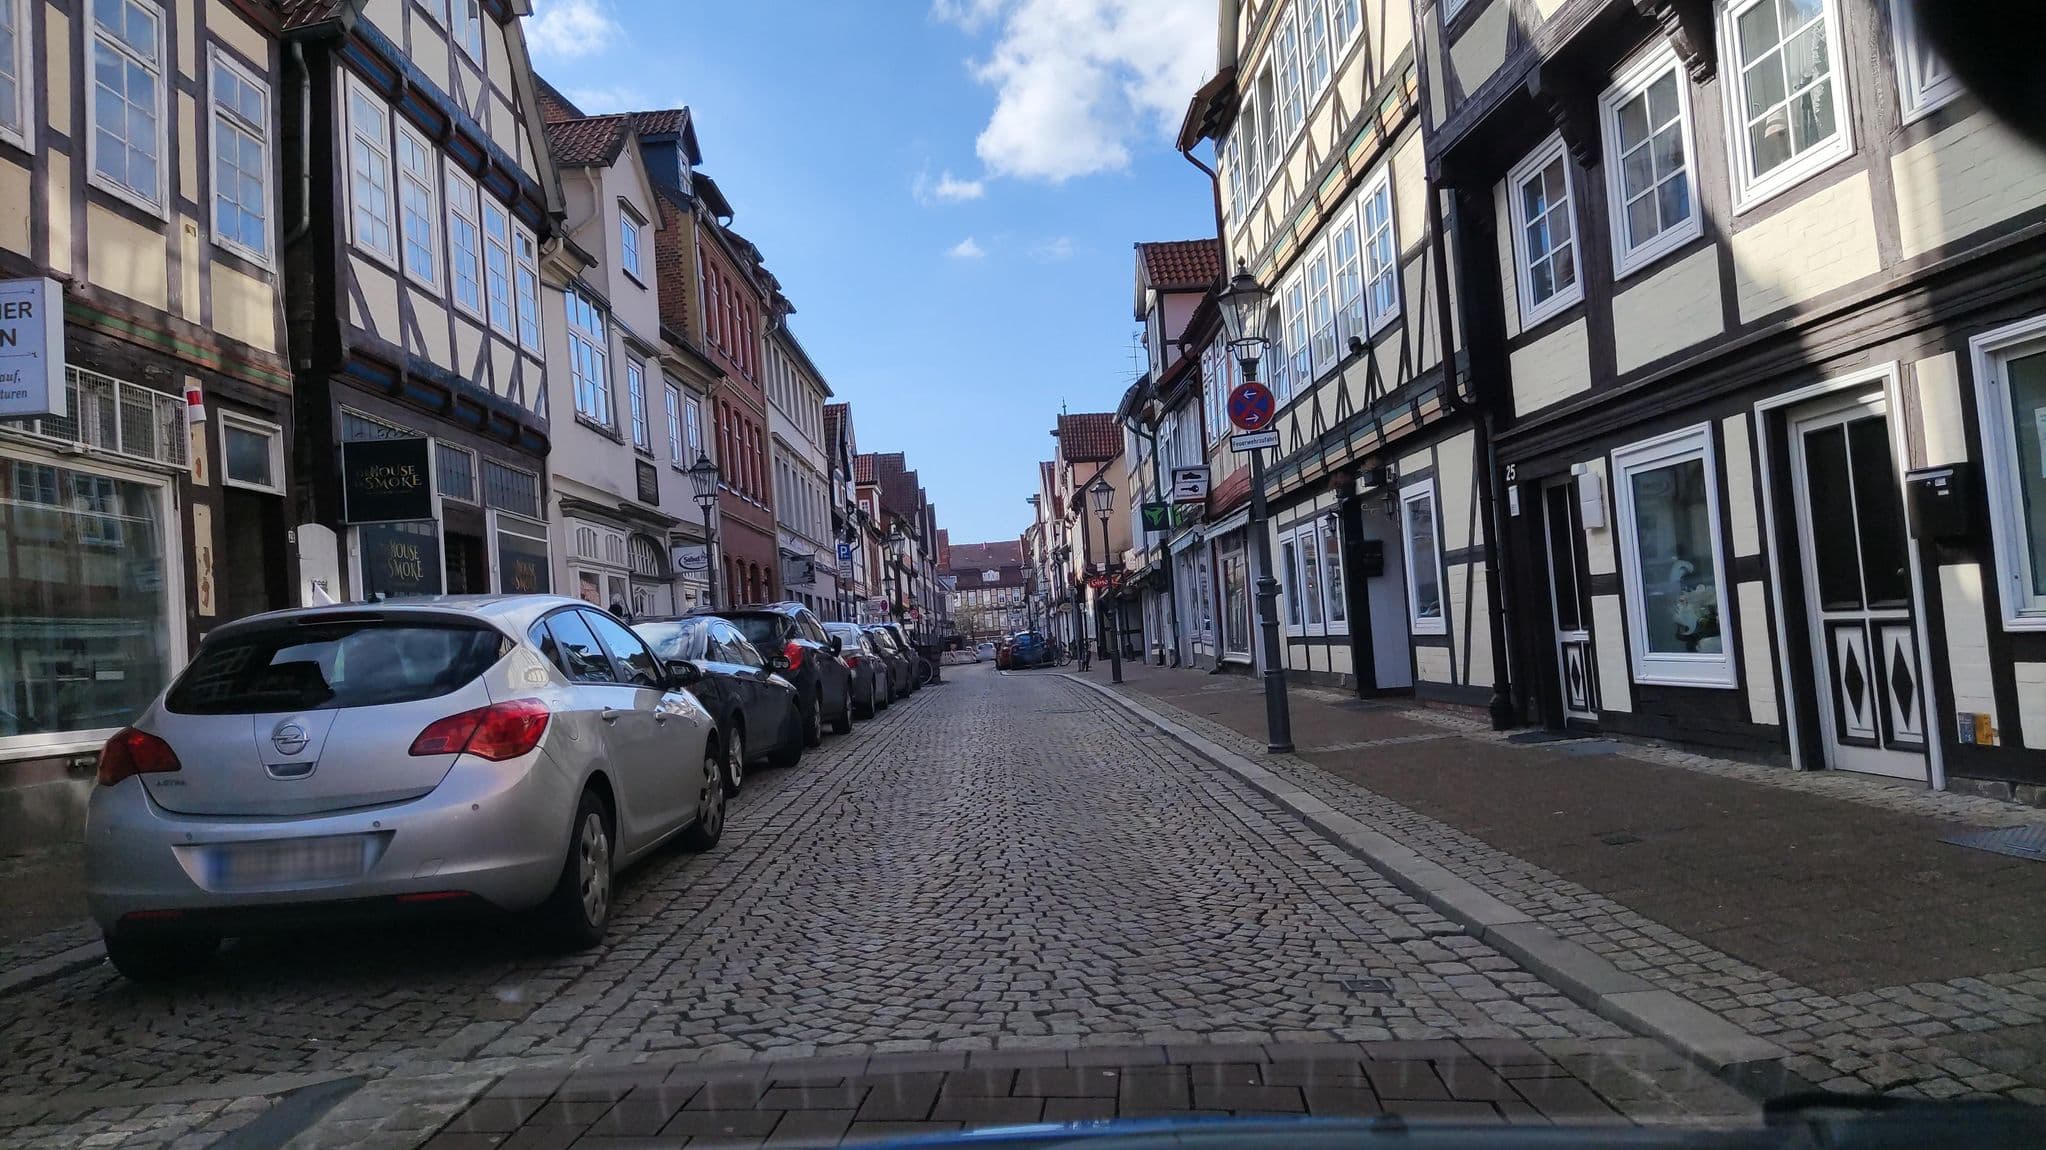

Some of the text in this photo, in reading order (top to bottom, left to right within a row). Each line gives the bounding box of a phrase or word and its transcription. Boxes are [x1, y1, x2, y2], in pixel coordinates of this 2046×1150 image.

[0, 301, 32, 319] ER
[1506, 463, 1516, 481] 25
[365, 474, 422, 490] SMOKE
[840, 546, 848, 559] P
[387, 559, 424, 581] SMOKE
